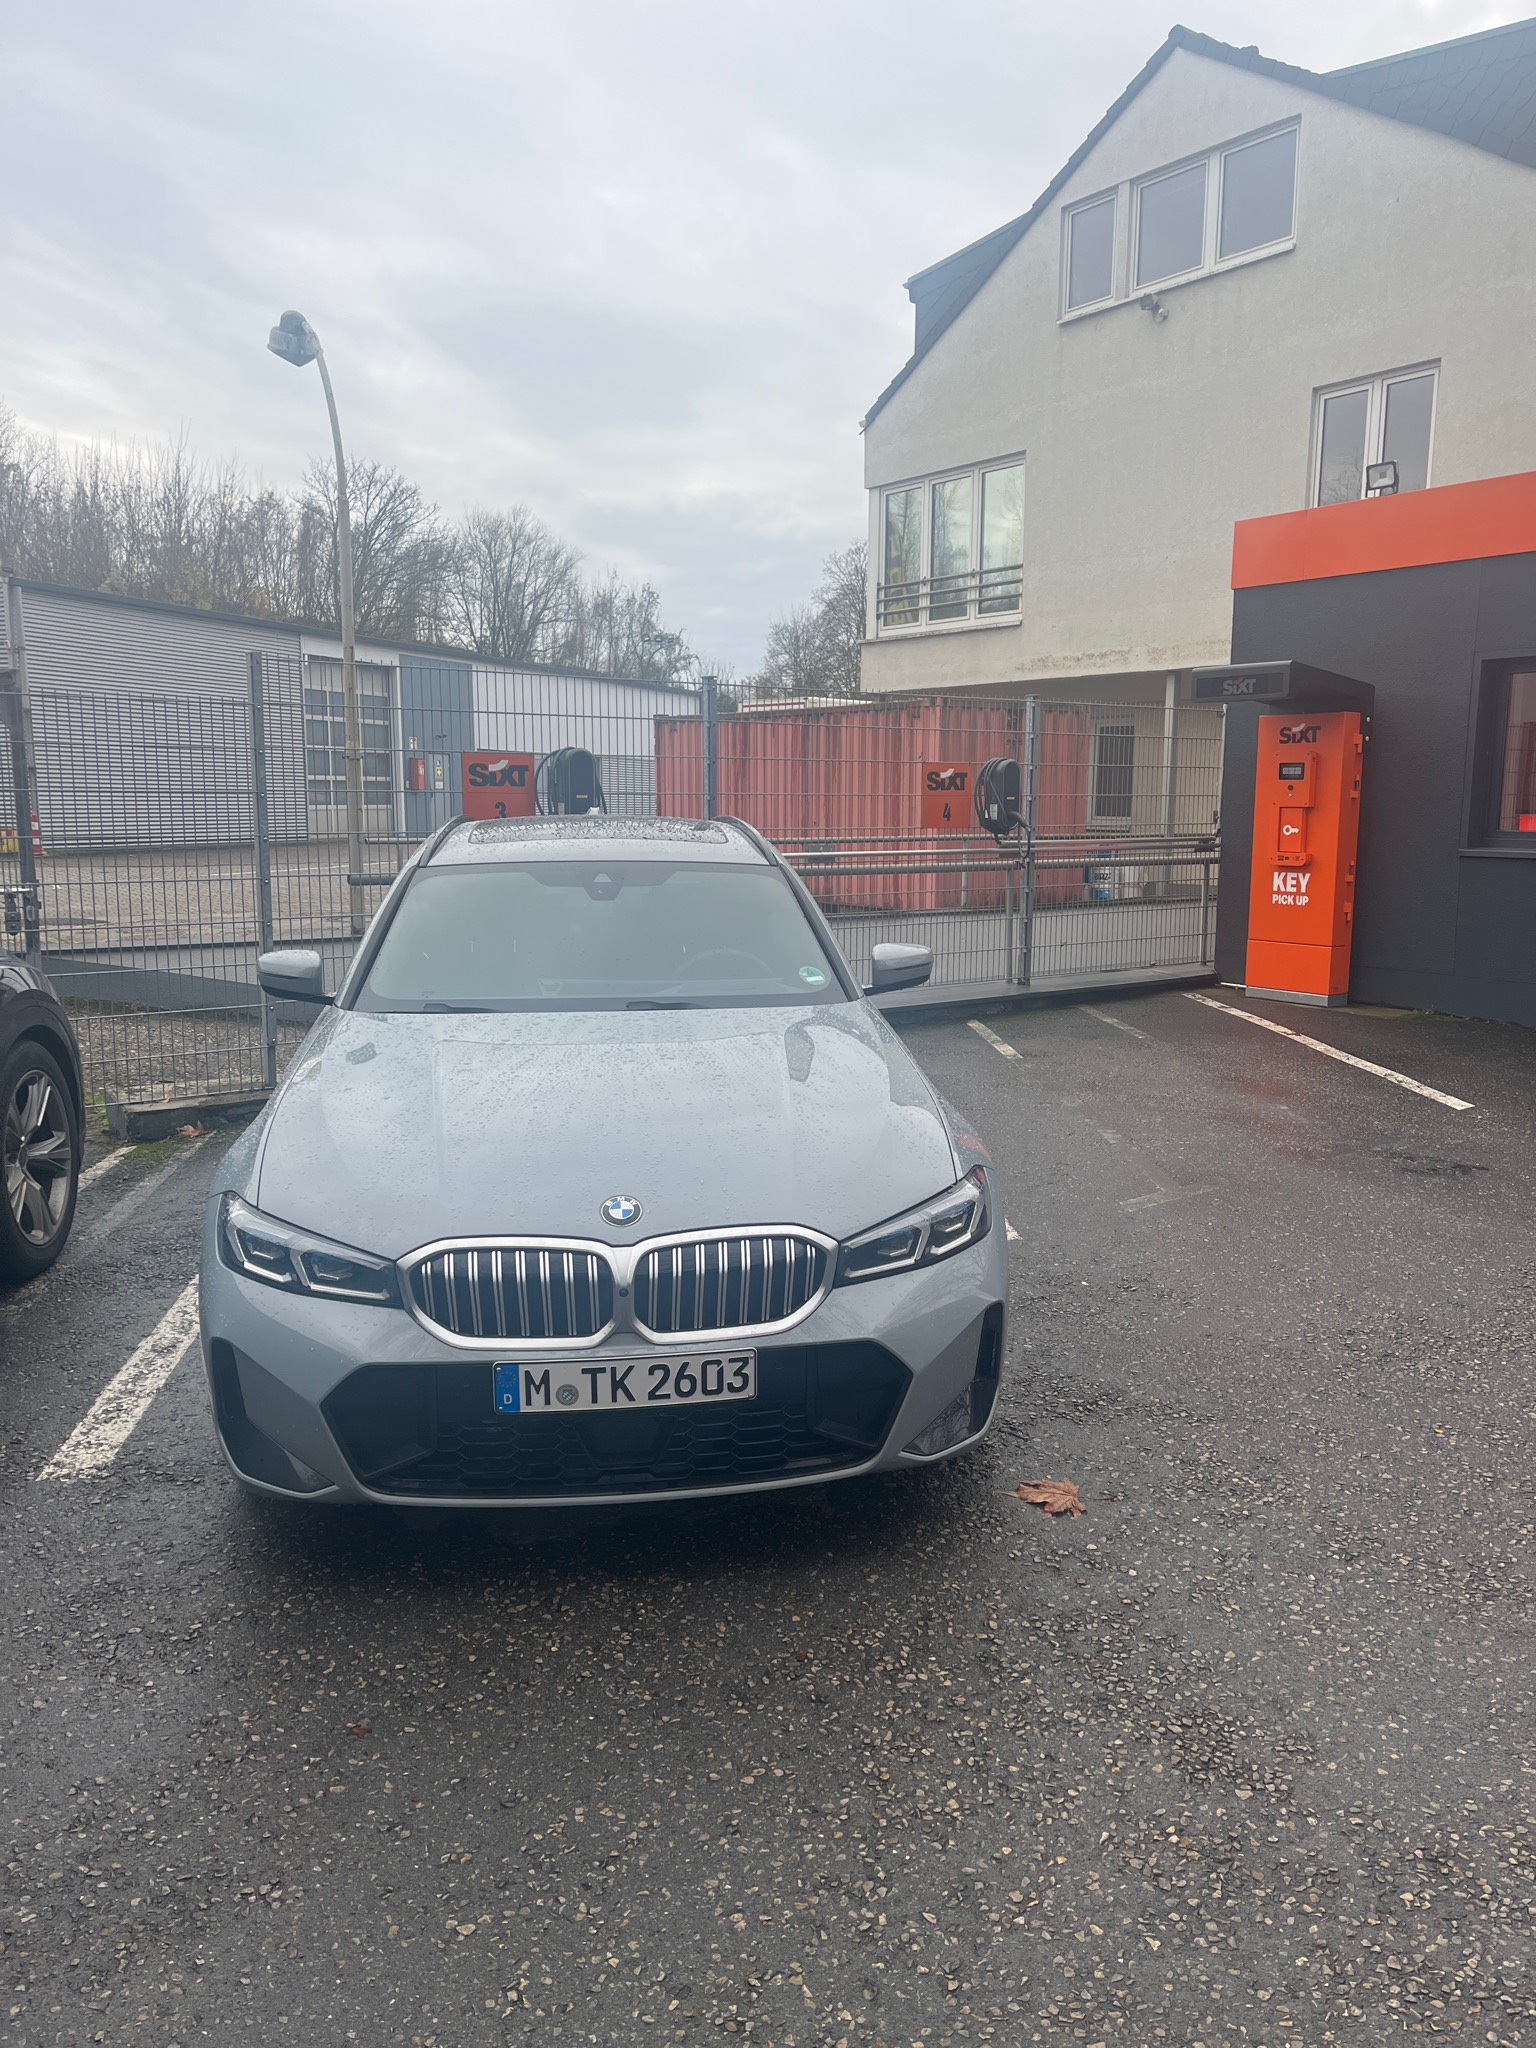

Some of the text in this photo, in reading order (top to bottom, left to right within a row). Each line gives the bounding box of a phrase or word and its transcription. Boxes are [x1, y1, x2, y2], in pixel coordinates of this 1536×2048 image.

[1222, 677, 1257, 695] SIXT
[1279, 722, 1322, 745] SIXT
[468, 759, 529, 787] SIXT
[926, 767, 968, 791] SIXT
[494, 801, 507, 819] 3
[942, 802, 952, 822] 4
[1272, 871, 1311, 893] KEY
[1272, 893, 1310, 906] PICK UP
[524, 1356, 750, 1407] M TK 2603
[503, 1393, 513, 1405] D
